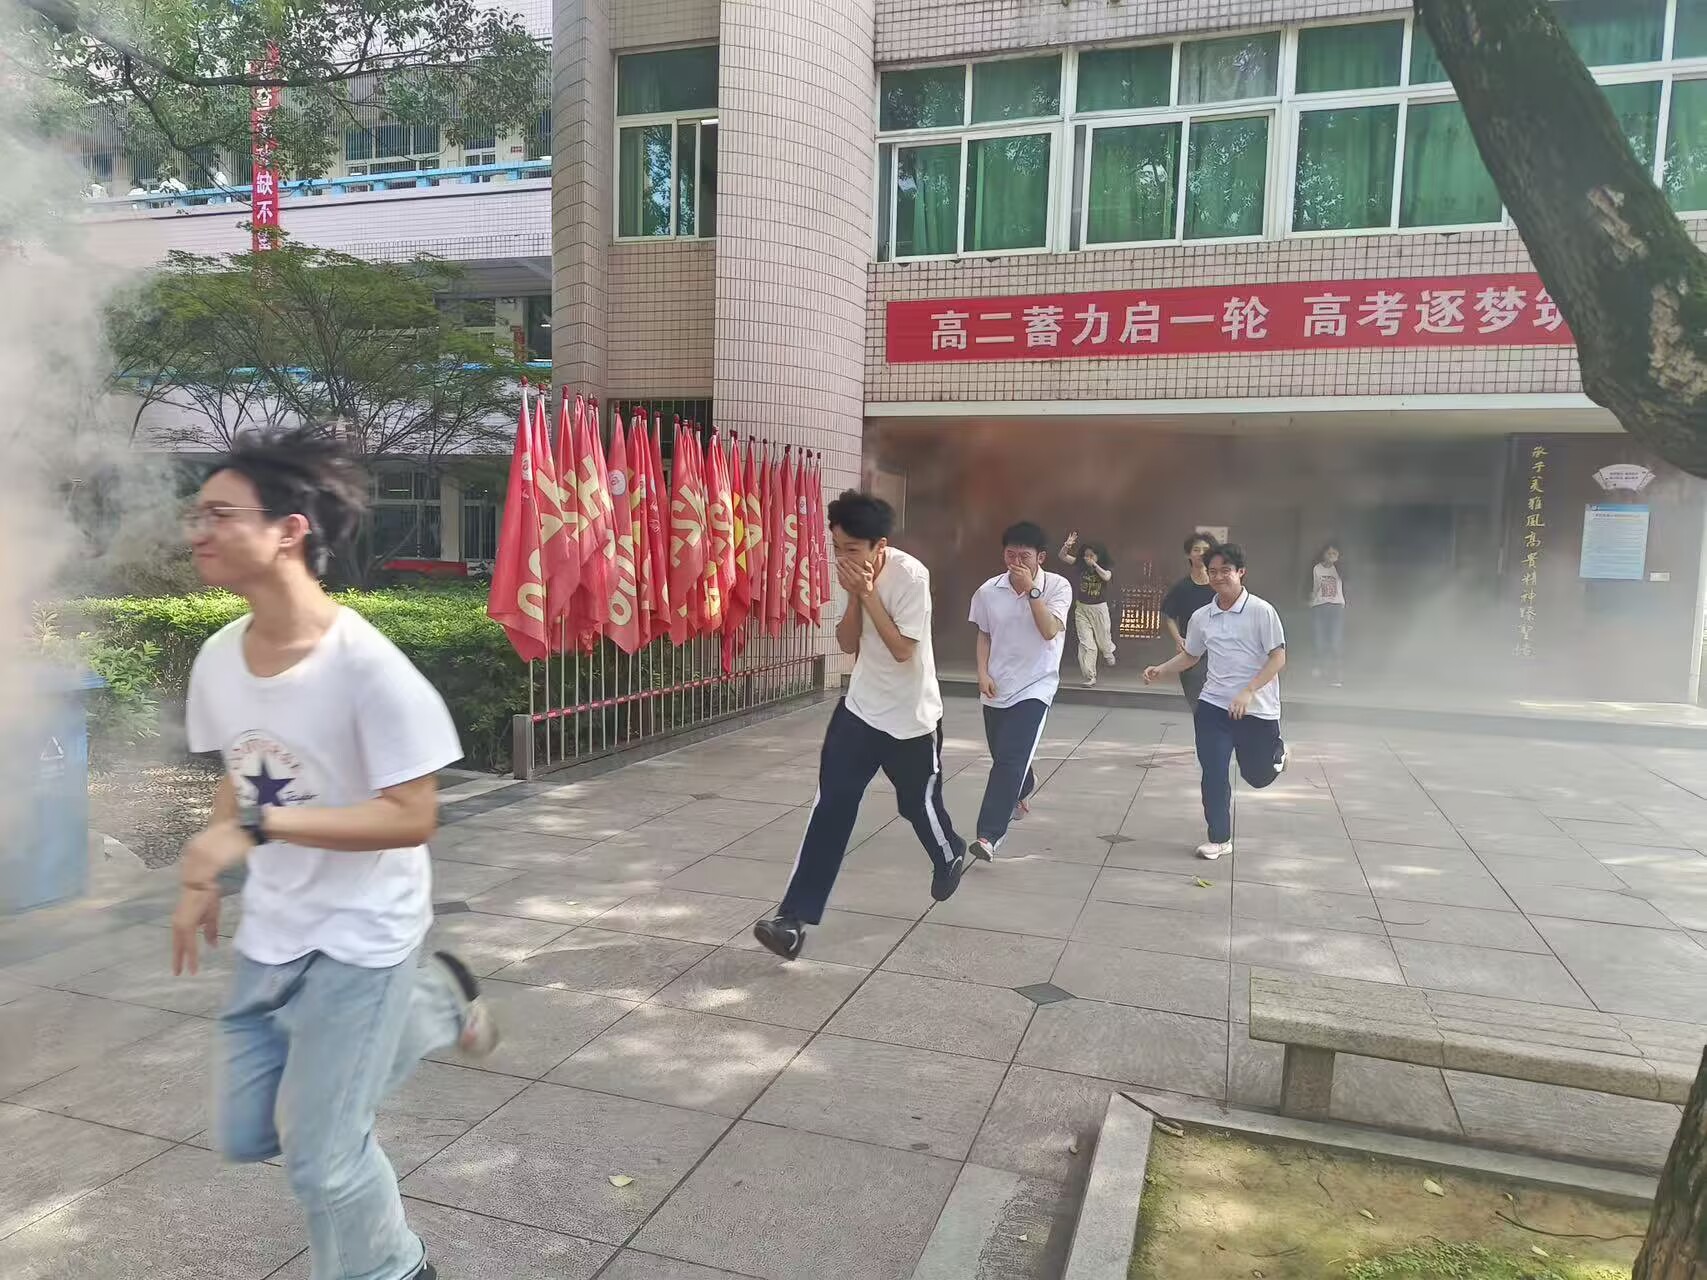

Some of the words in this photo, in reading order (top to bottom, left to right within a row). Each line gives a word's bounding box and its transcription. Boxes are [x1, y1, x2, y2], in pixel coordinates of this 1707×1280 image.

[931, 295, 1270, 350] 高二蓄力启一轮
